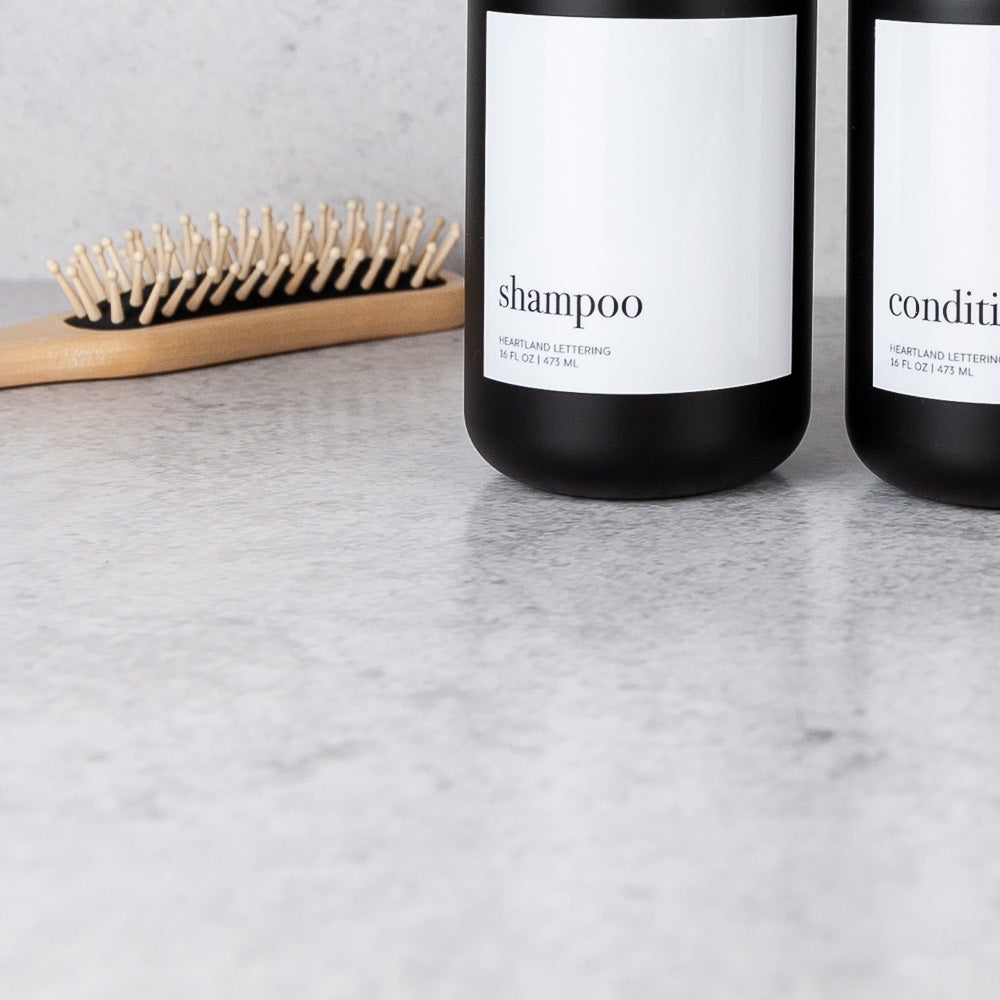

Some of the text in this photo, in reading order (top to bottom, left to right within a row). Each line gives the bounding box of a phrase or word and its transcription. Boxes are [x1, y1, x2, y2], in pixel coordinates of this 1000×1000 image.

[498, 274, 644, 330] shampoo
[499, 335, 612, 357] HEARTLAND LETTERING
[889, 343, 945, 361] HEARTLAND
[499, 348, 508, 360] 16
[509, 350, 519, 362] FL
[521, 353, 535, 364] OZ
[542, 356, 561, 367] 473
[563, 358, 579, 369] ML
[890, 357, 900, 368] 16
[901, 359, 912, 370] FL
[914, 361, 929, 373] OZ
[936, 364, 955, 376] 473
[958, 366, 974, 378] ML
